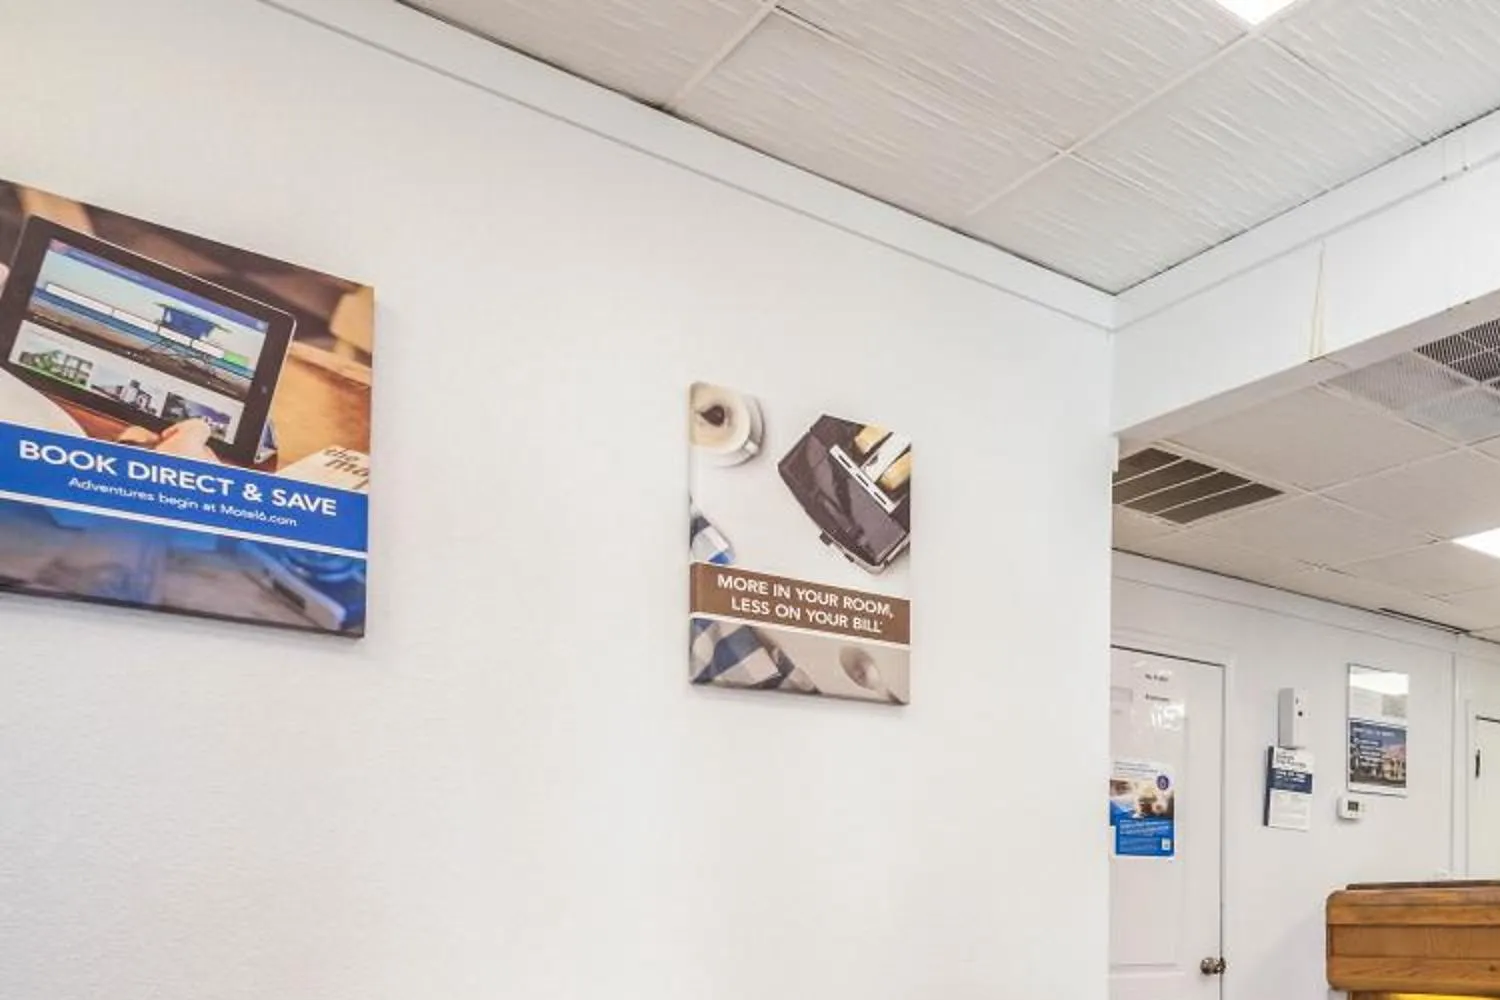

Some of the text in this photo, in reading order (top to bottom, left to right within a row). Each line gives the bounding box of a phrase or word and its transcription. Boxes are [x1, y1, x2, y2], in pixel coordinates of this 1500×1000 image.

[19, 439, 337, 516] BOOK DIRECT & SAVE
[68, 477, 297, 527] Adventures begin at Motel6.com
[717, 574, 894, 619] MORE IN YOUR ROOM,
[732, 596, 770, 615] LESS
[775, 603, 800, 621] ON
[806, 609, 848, 628] YOUR
